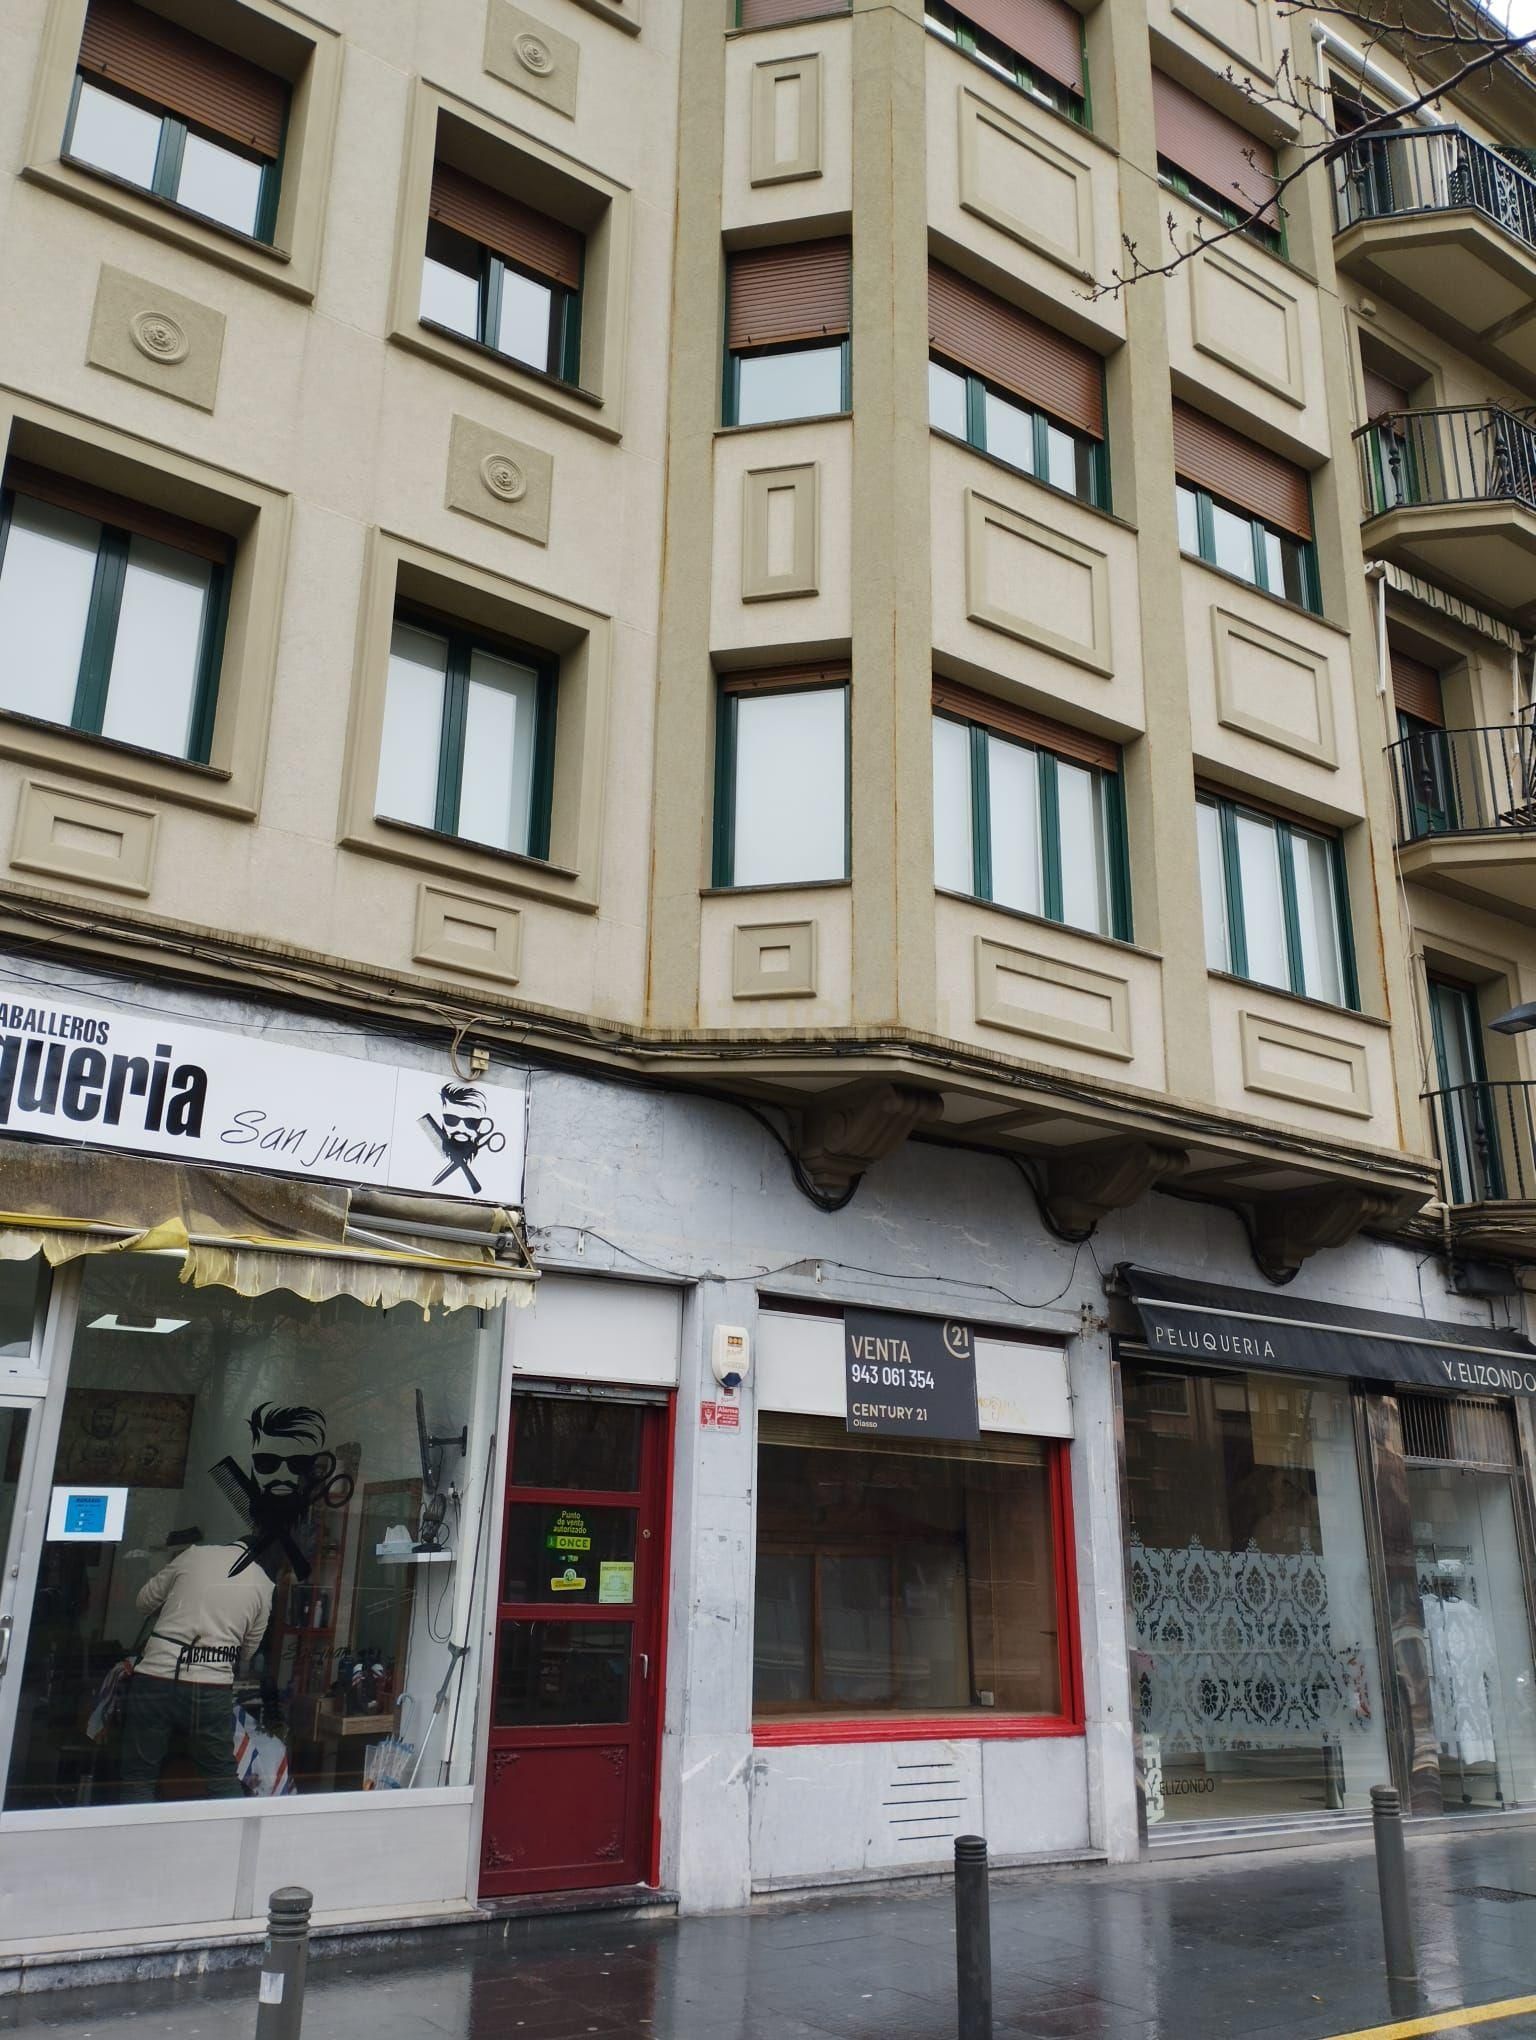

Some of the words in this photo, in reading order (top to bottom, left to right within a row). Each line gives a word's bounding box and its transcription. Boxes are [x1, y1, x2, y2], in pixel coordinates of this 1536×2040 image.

[220, 1110, 308, 1154] San
[300, 1125, 388, 1167] juan
[851, 1335, 912, 1364] VENTA
[1155, 1326, 1275, 1358] PELUQUERIA
[851, 1363, 879, 1384] 943
[882, 1366, 906, 1387] 061
[908, 1369, 935, 1389] 354
[1442, 1360, 1456, 1381] Y.
[1458, 1362, 1536, 1392] ELIZONDO
[852, 1403, 913, 1420] CENTURY
[916, 1408, 928, 1421] 21
[853, 1419, 878, 1428] Oiasso
[561, 1510, 581, 1519] Punto
[566, 1518, 584, 1527] venta
[553, 1526, 587, 1534] autorizado
[559, 1538, 589, 1548] ONCE
[179, 1645, 242, 1664] CABALLEROS
[1160, 1778, 1214, 1796] ELIZONDO
